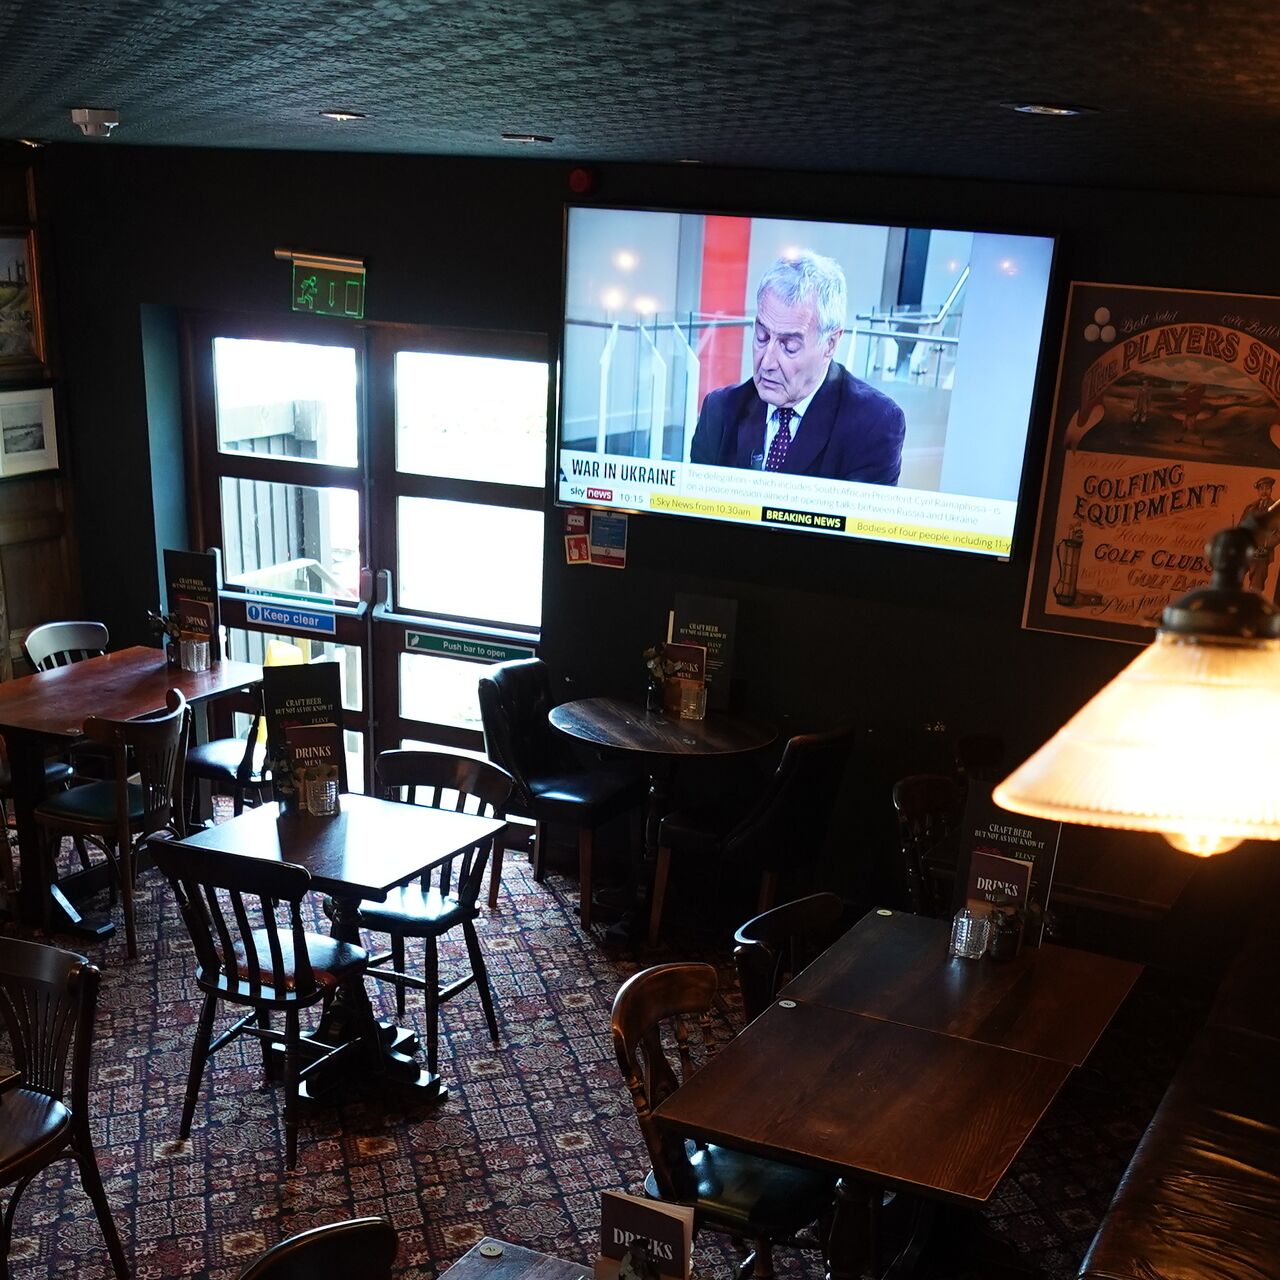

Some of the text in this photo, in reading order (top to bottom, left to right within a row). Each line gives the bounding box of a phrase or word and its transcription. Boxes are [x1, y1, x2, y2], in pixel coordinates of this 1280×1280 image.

[1122, 325, 1240, 372] PLAYERS
[572, 459, 676, 486] WAR IN UKRAINE
[1083, 464, 1184, 500] GOLFING
[570, 486, 644, 504] sky news 10:15
[814, 485, 839, 496] South
[1073, 483, 1228, 527] EQUIPMENT
[657, 497, 671, 509] Sky
[672, 498, 694, 510] News
[695, 502, 715, 513] from
[766, 509, 813, 525] BREAKING
[814, 515, 841, 529] NEWS
[857, 522, 887, 535] Bodies
[888, 525, 897, 535] of
[898, 526, 917, 538] four
[952, 534, 993, 550] including
[1094, 544, 1145, 565] GOLF
[264, 608, 320, 627] Keep clear
[443, 640, 506, 658] Push bar to open
[285, 697, 322, 708] CRAFT BEER
[295, 745, 332, 760] DRINKS
[989, 823, 1033, 840] CRAFT BEER
[976, 876, 1019, 898] DRINKS
